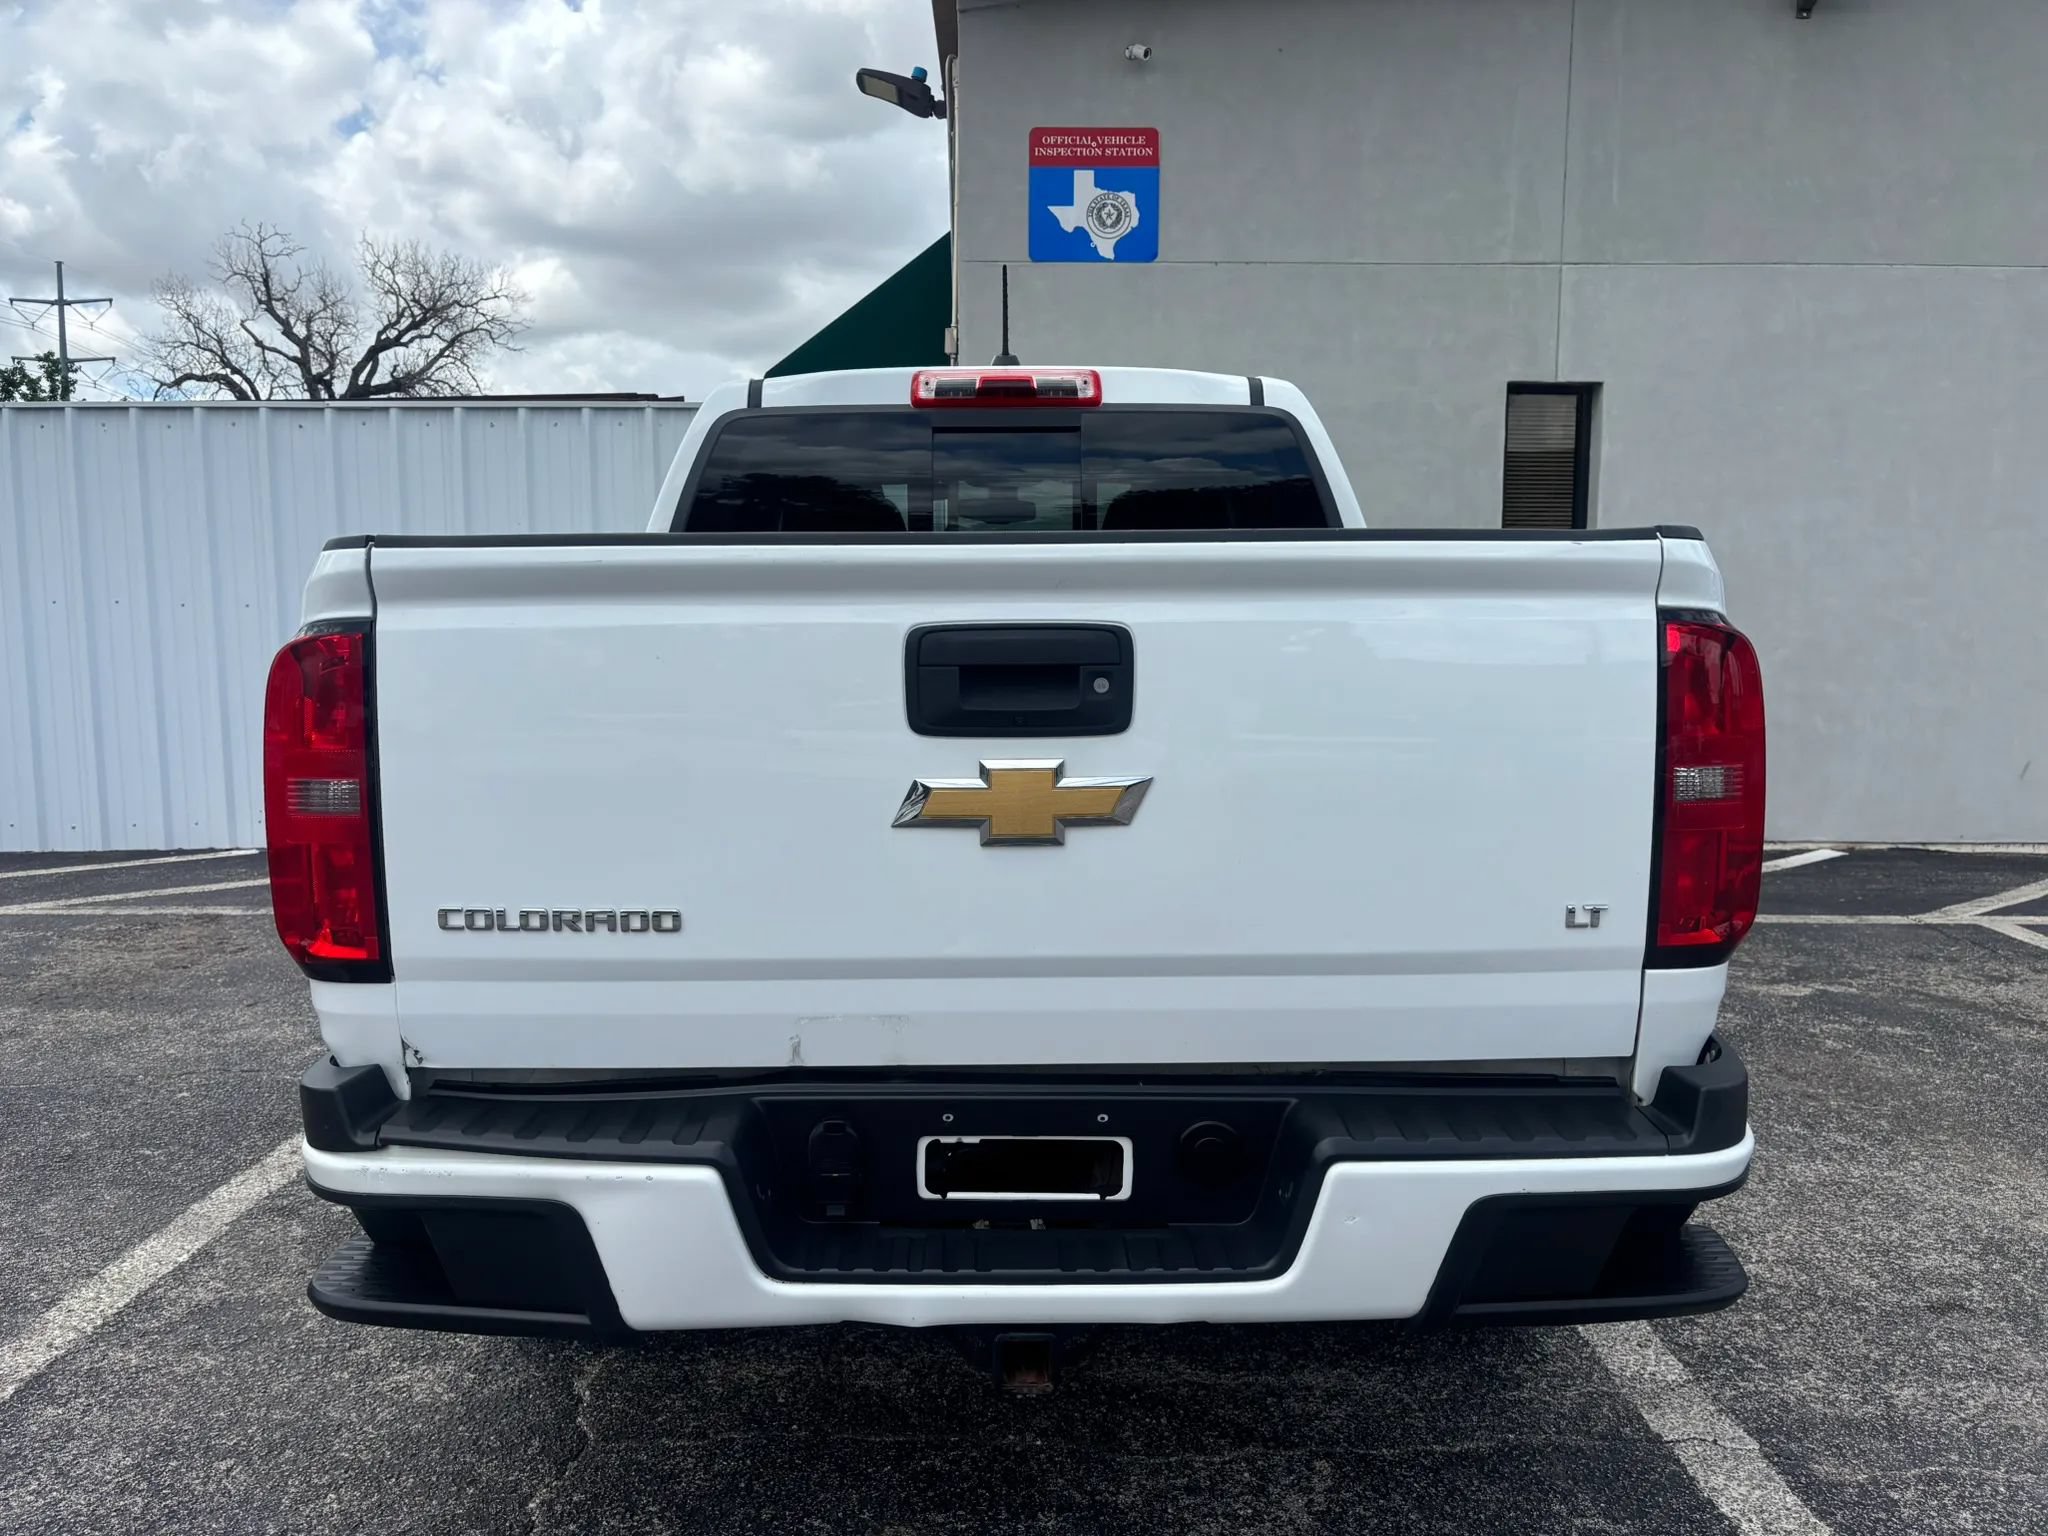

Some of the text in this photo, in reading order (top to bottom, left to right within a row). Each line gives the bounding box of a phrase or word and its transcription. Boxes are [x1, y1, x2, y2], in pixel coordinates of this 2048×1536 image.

[1042, 136, 1146, 145] OFFICIAL VEHICLE
[1035, 147, 1153, 156] INSPECTION STATION
[438, 907, 682, 932] COLORADO
[1565, 904, 1608, 928] LT
